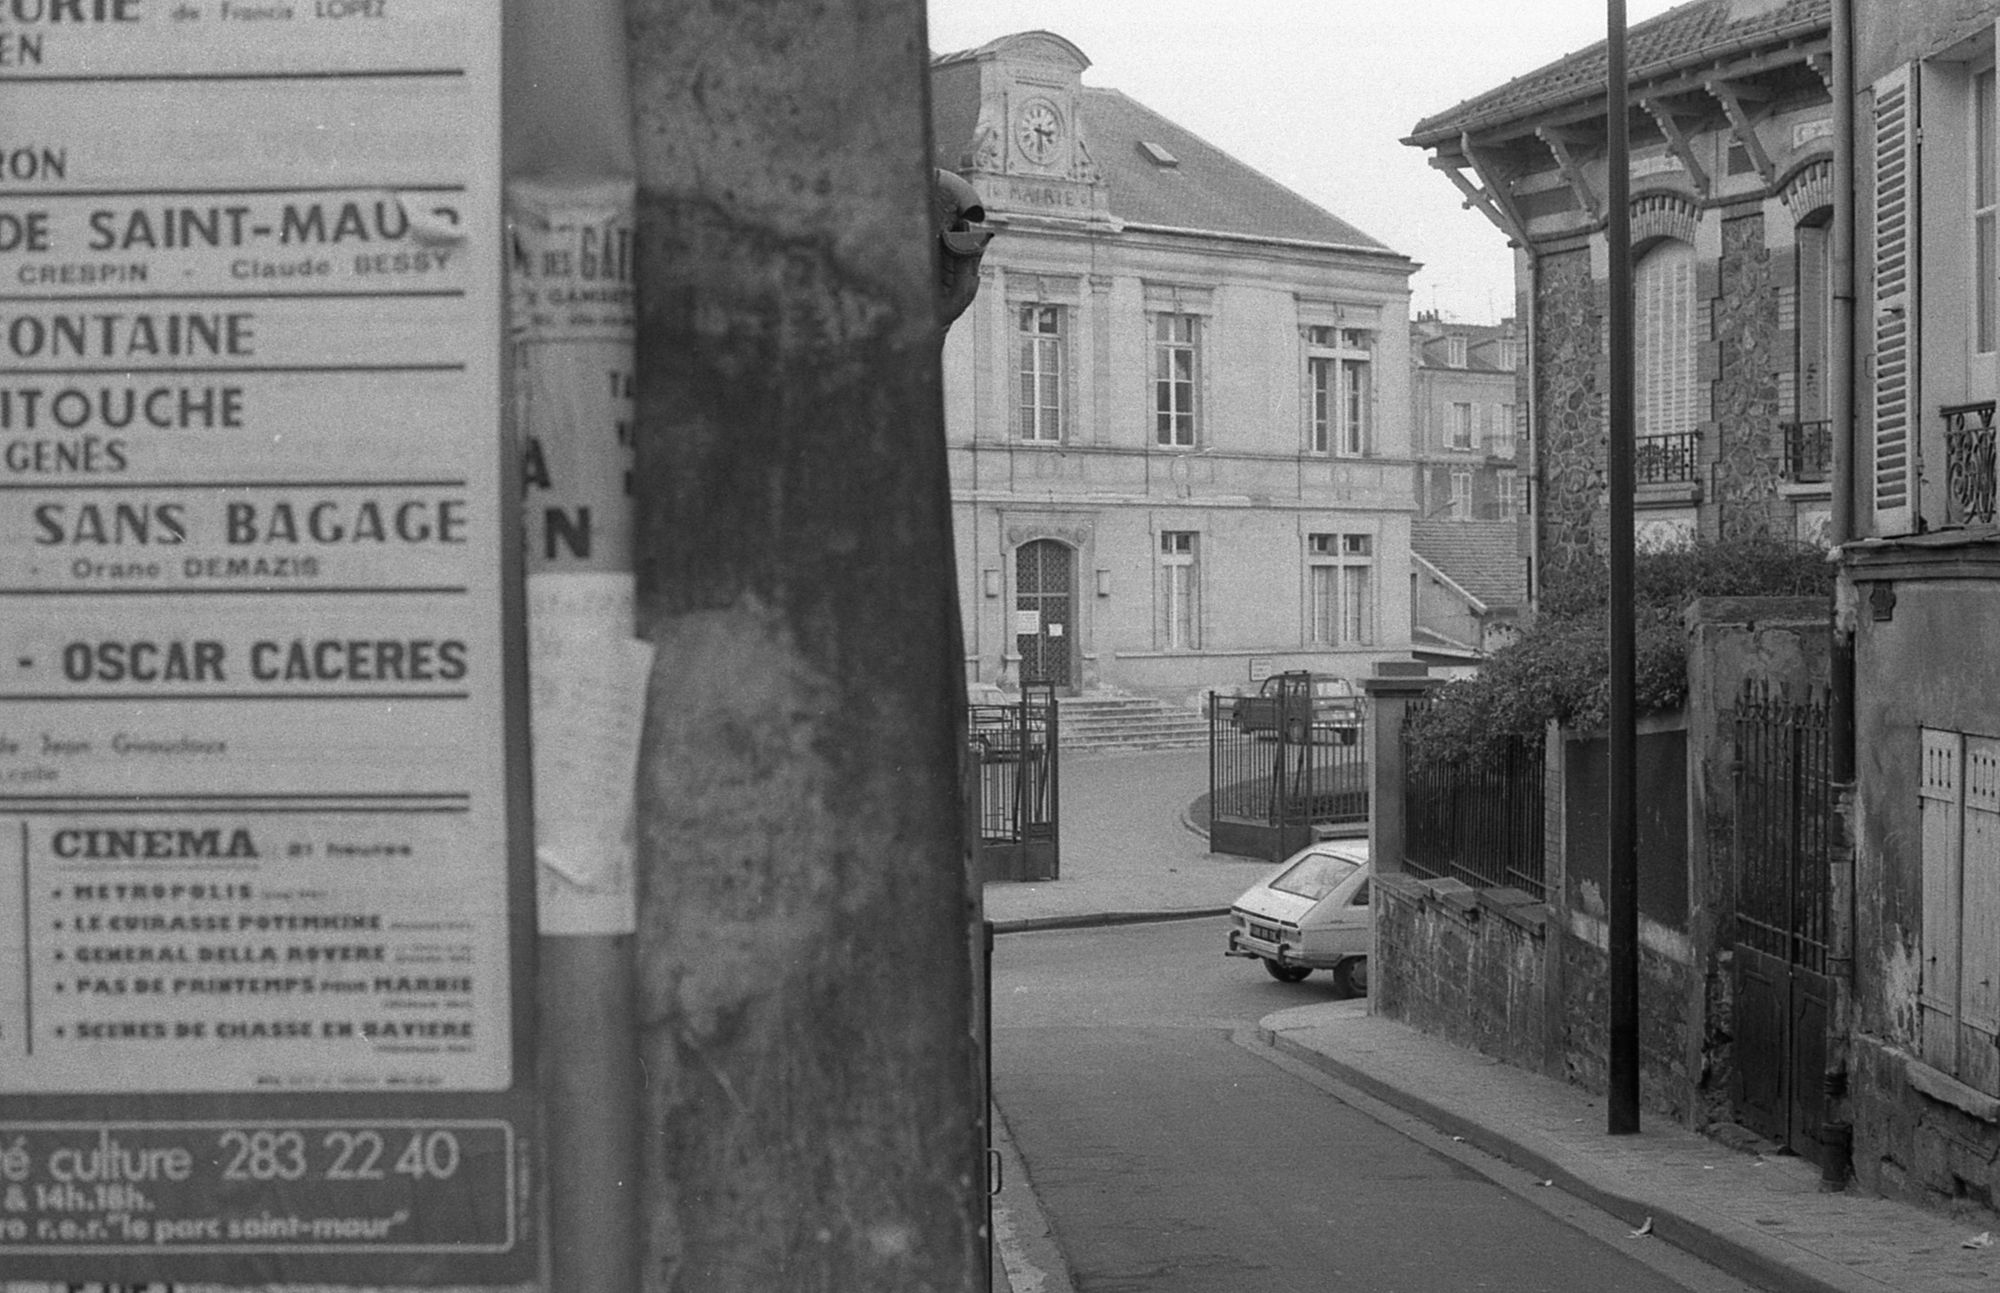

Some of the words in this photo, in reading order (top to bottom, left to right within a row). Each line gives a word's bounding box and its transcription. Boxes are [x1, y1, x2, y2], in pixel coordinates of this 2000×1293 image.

[0, 0, 140, 23] URIE
[0, 148, 66, 180] ON
[89, 201, 459, 250] SAINT-MAU
[231, 258, 331, 279] Claude
[0, 315, 254, 357] ONTAINE
[34, 503, 186, 545] SANS
[226, 501, 467, 545] BAGAGE
[63, 641, 226, 682] OSCAR
[249, 640, 468, 681] CACERES
[52, 829, 259, 860] CINEMA
[74, 885, 251, 900] METROPOLIS
[77, 979, 127, 994] PAS
[216, 1022, 312, 1038] CHASSE
[50, 1126, 194, 1182] culture
[219, 1130, 307, 1181] 283
[324, 1130, 385, 1181] 22
[395, 1130, 460, 1181] 40
